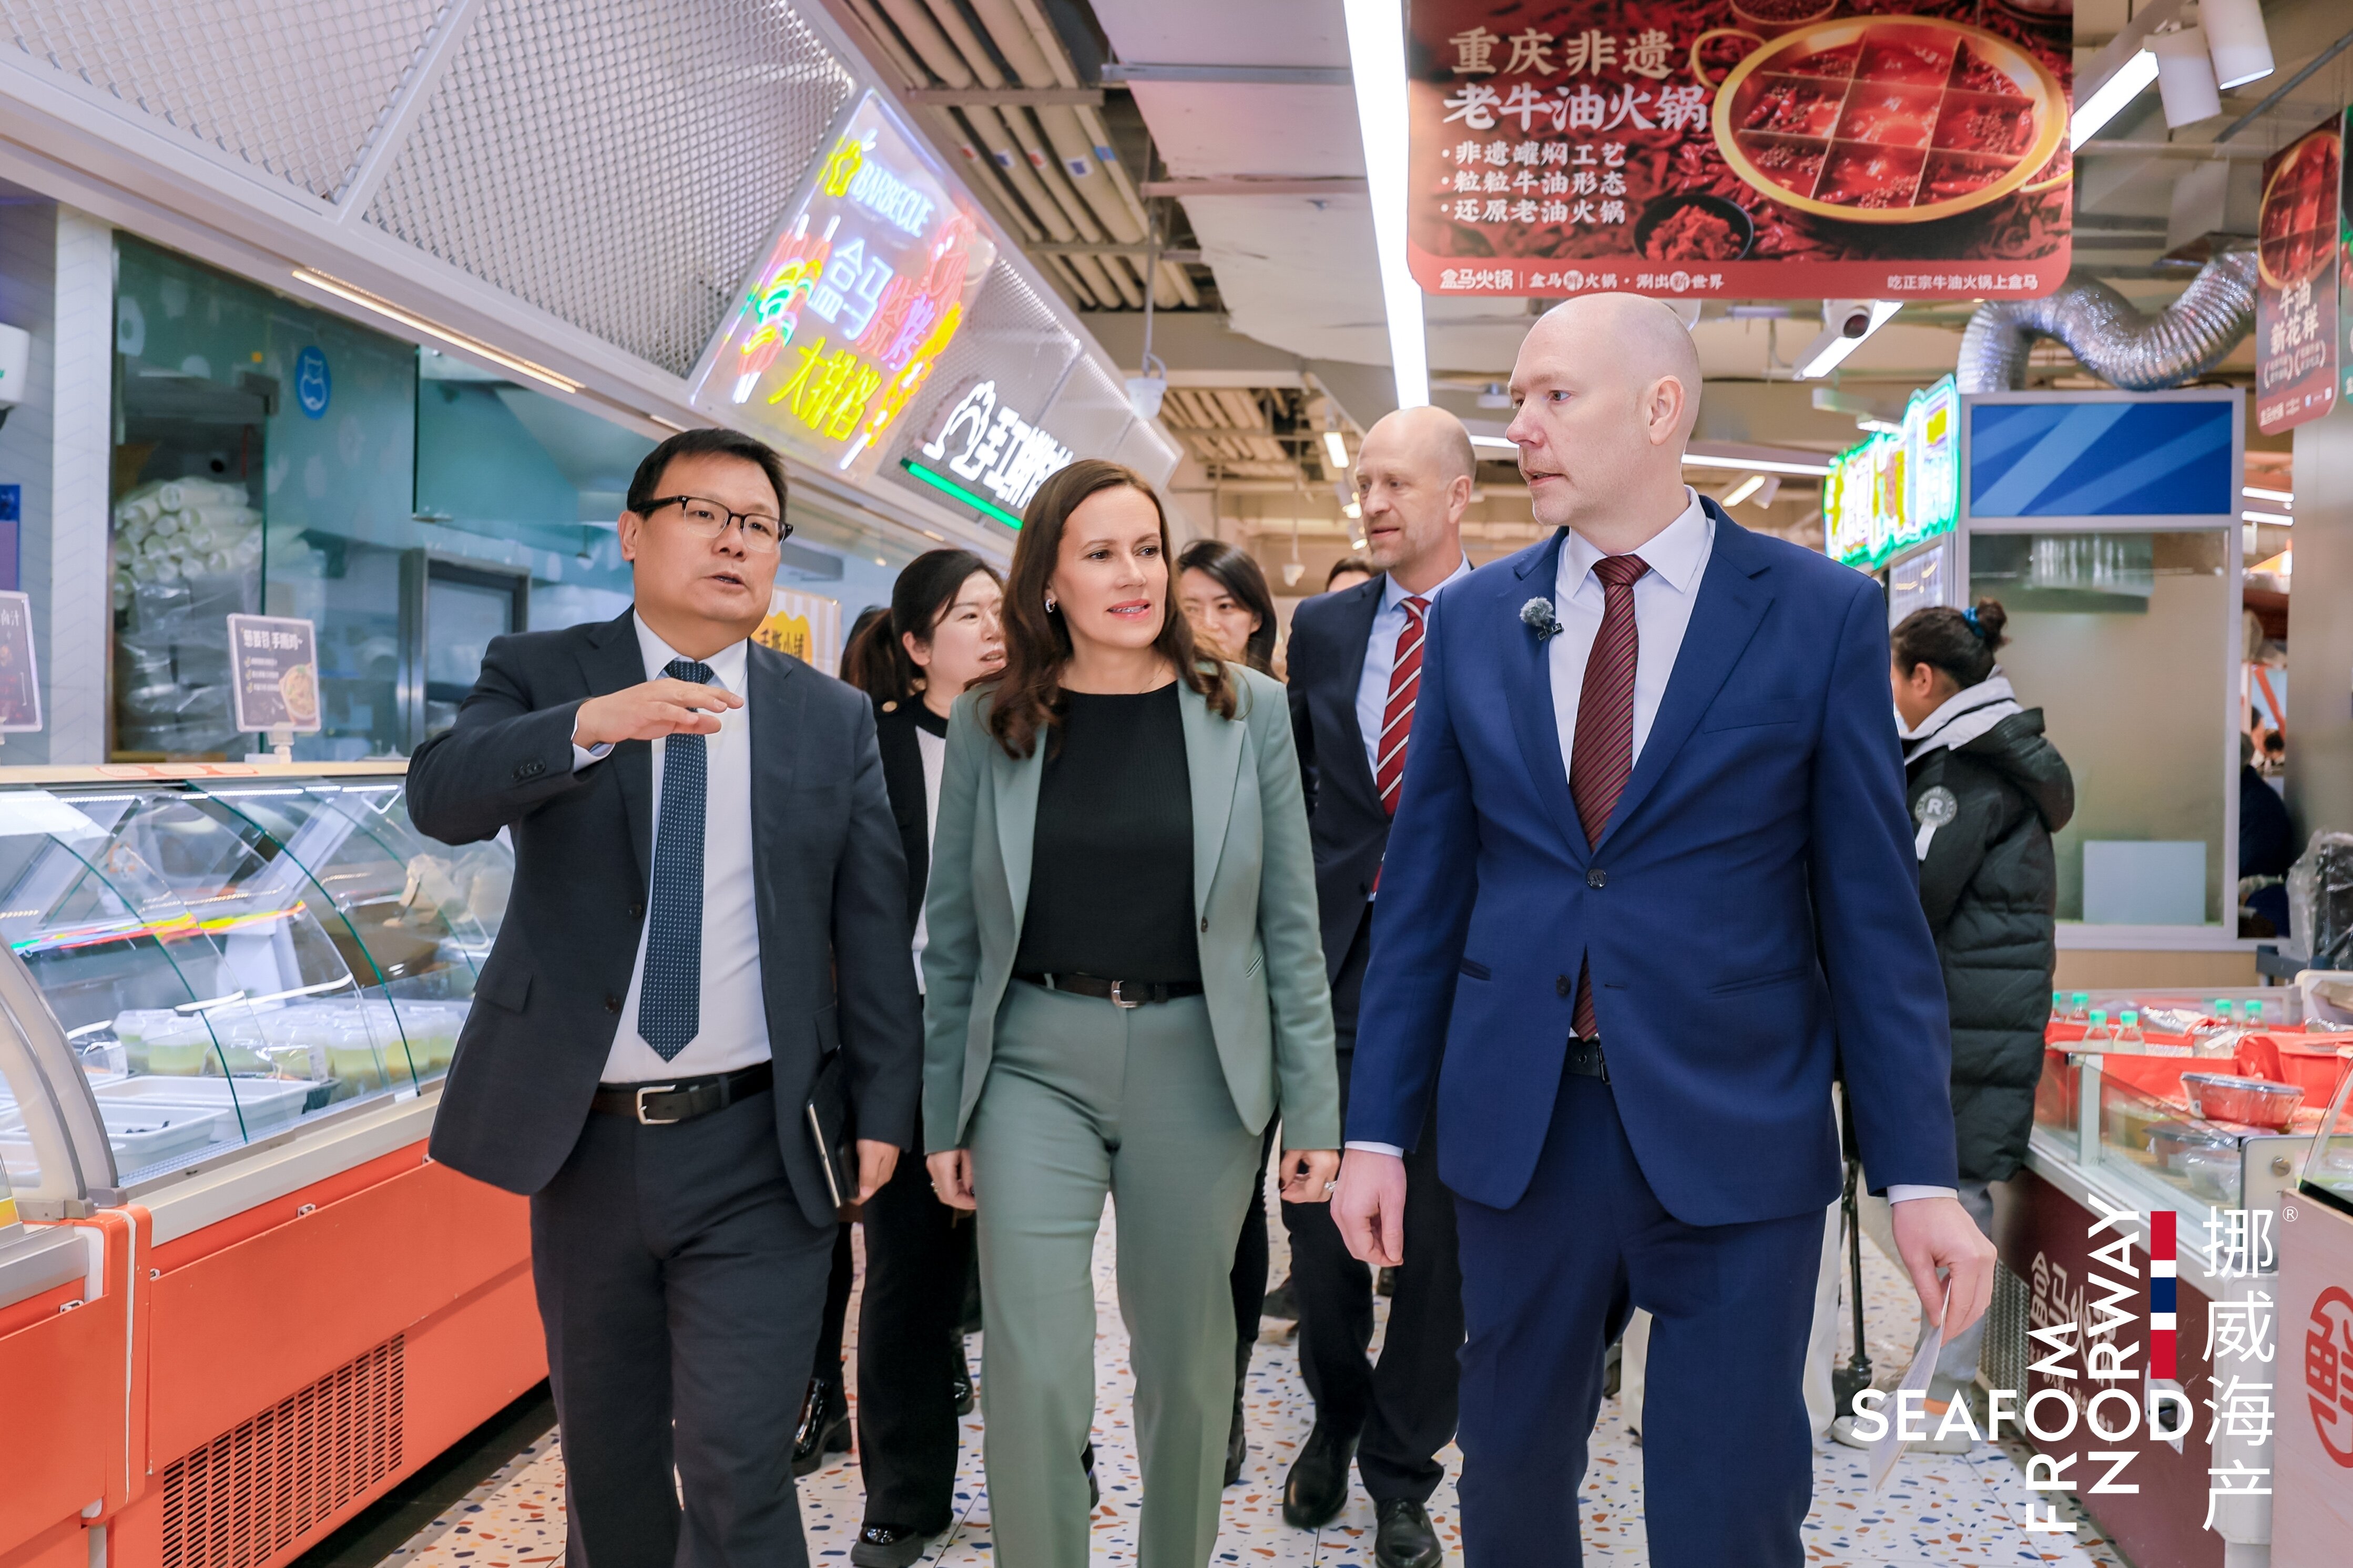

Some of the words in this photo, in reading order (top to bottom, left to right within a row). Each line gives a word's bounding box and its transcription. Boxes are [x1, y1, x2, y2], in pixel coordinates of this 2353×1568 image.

[1449, 26, 1674, 80] 重庆非遗
[1443, 82, 1708, 132] 老牛油火锅
[1455, 140, 1626, 167] 非遗罐焖工艺
[851, 159, 935, 238] BARBECUE
[1453, 170, 1627, 197] 粒粒牛油形态
[1454, 198, 1625, 224] 还原老油火锅
[1439, 268, 1514, 290] 盒马火锅
[1887, 273, 2039, 290] 吃正宗牛油火锅上盒马
[2278, 276, 2311, 317] 牛油
[806, 237, 935, 372] 盒马烧烤
[2270, 303, 2319, 356] 新花样
[768, 335, 883, 442] 大排档
[1927, 798, 1943, 815] R
